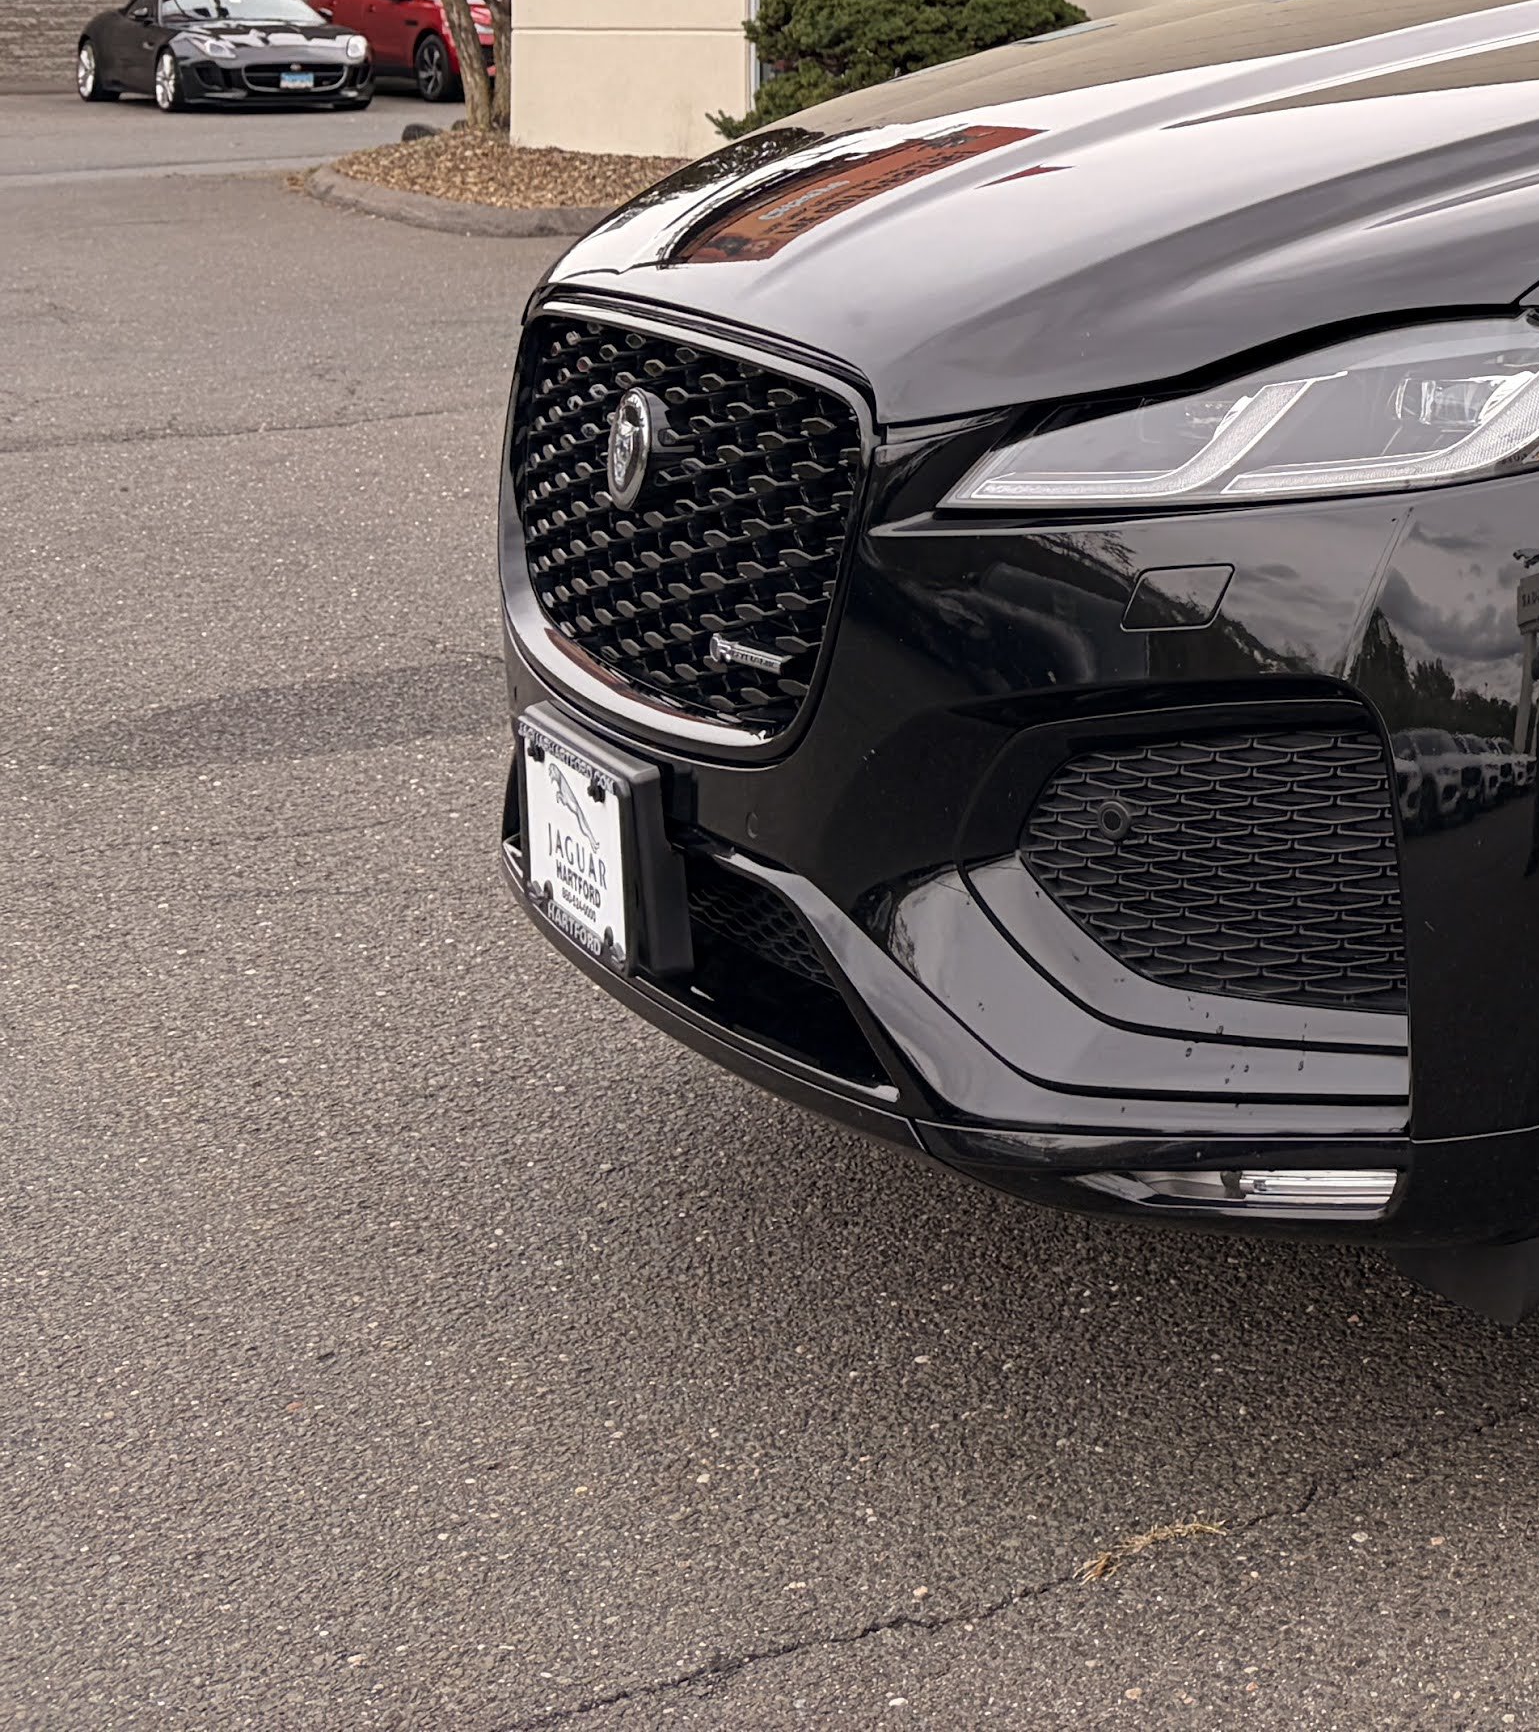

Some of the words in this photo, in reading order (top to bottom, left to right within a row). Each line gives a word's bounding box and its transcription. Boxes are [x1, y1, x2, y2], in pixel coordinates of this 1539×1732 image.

[547, 822, 607, 891] JAGUAR
[555, 857, 601, 909] HARTFORD
[547, 900, 602, 956] HARTFORD
